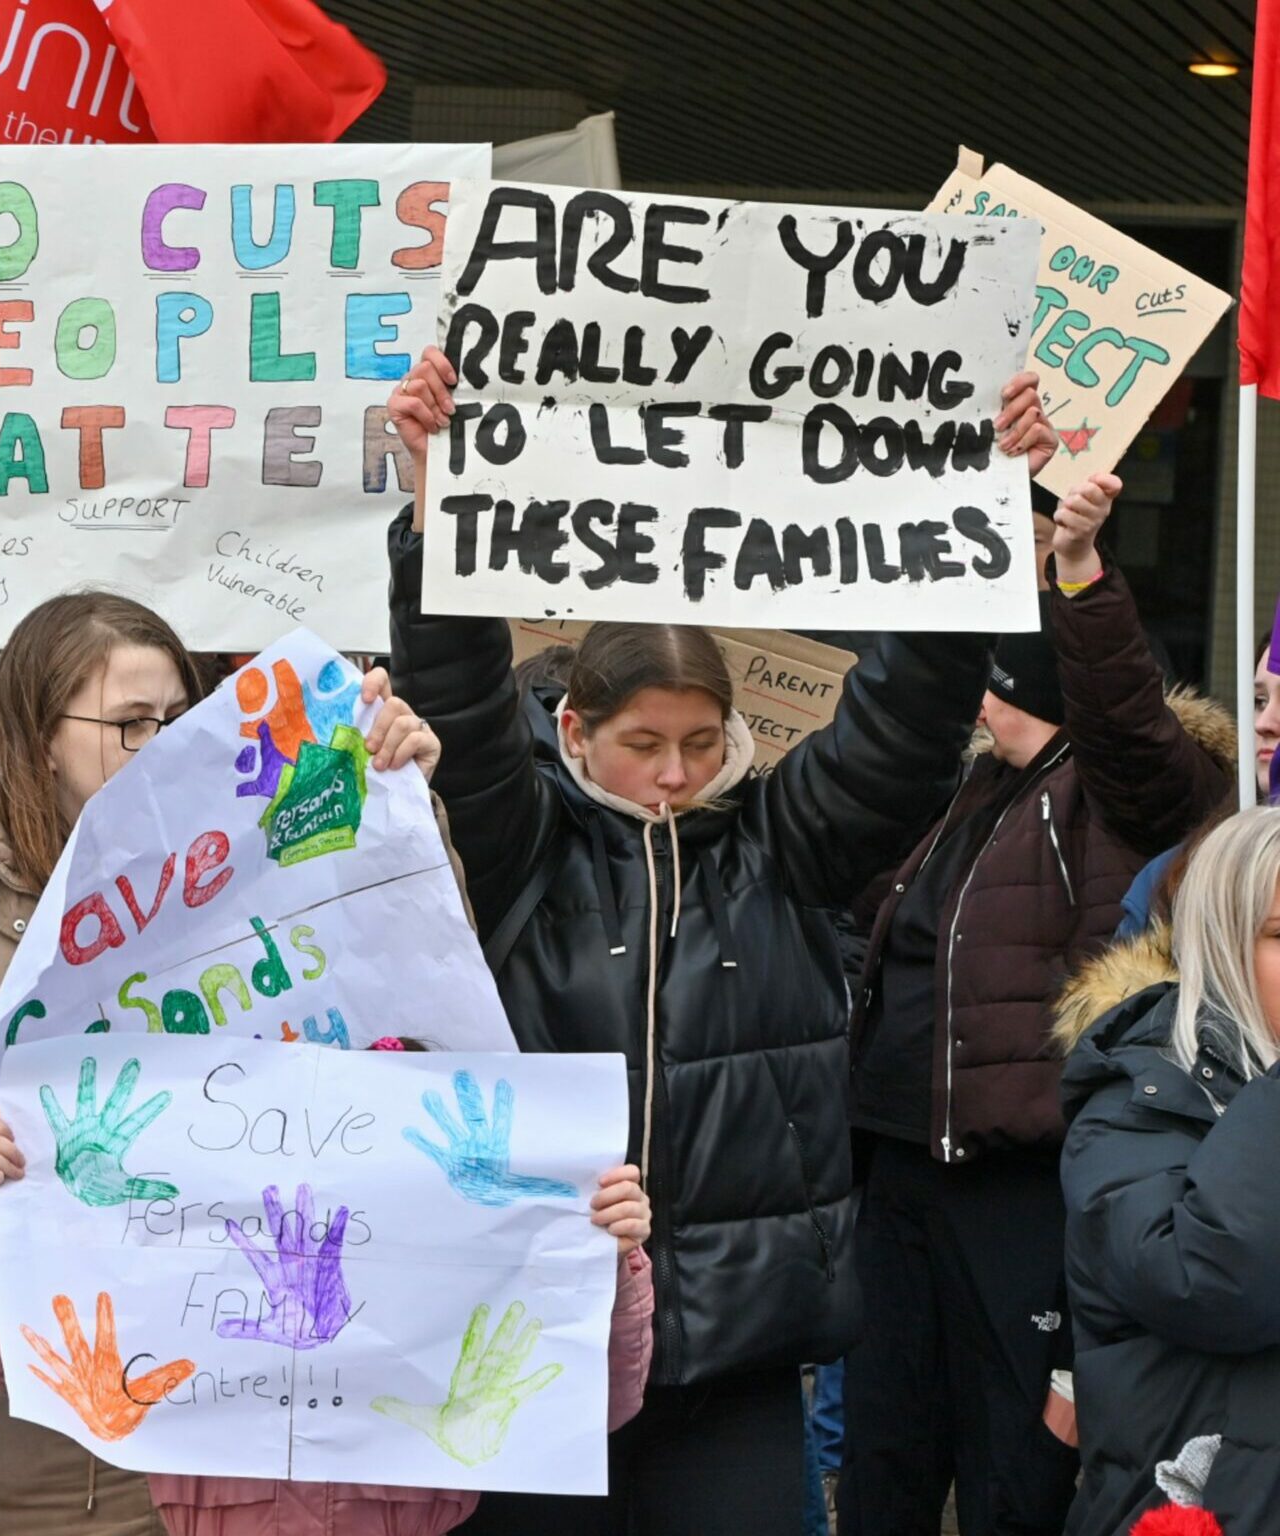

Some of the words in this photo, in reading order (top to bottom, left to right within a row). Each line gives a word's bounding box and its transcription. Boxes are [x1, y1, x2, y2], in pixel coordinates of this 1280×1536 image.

[141, 179, 450, 272] CUTS
[456, 186, 711, 303] ARE
[779, 214, 969, 319] YOU
[443, 303, 714, 389] REALLY
[749, 332, 975, 411] GOING
[445, 400, 526, 475] TO
[588, 399, 772, 470] LET
[802, 402, 996, 485] DOWN
[58, 496, 190, 525] SUPPORT
[440, 493, 659, 591] THESE
[681, 505, 1012, 603] FAMILIES
[208, 563, 306, 622] Vulnerable
[216, 530, 327, 593] Children
[744, 656, 834, 698] PARENT
[187, 1063, 377, 1158] Save
[121, 1173, 371, 1246] Fersands
